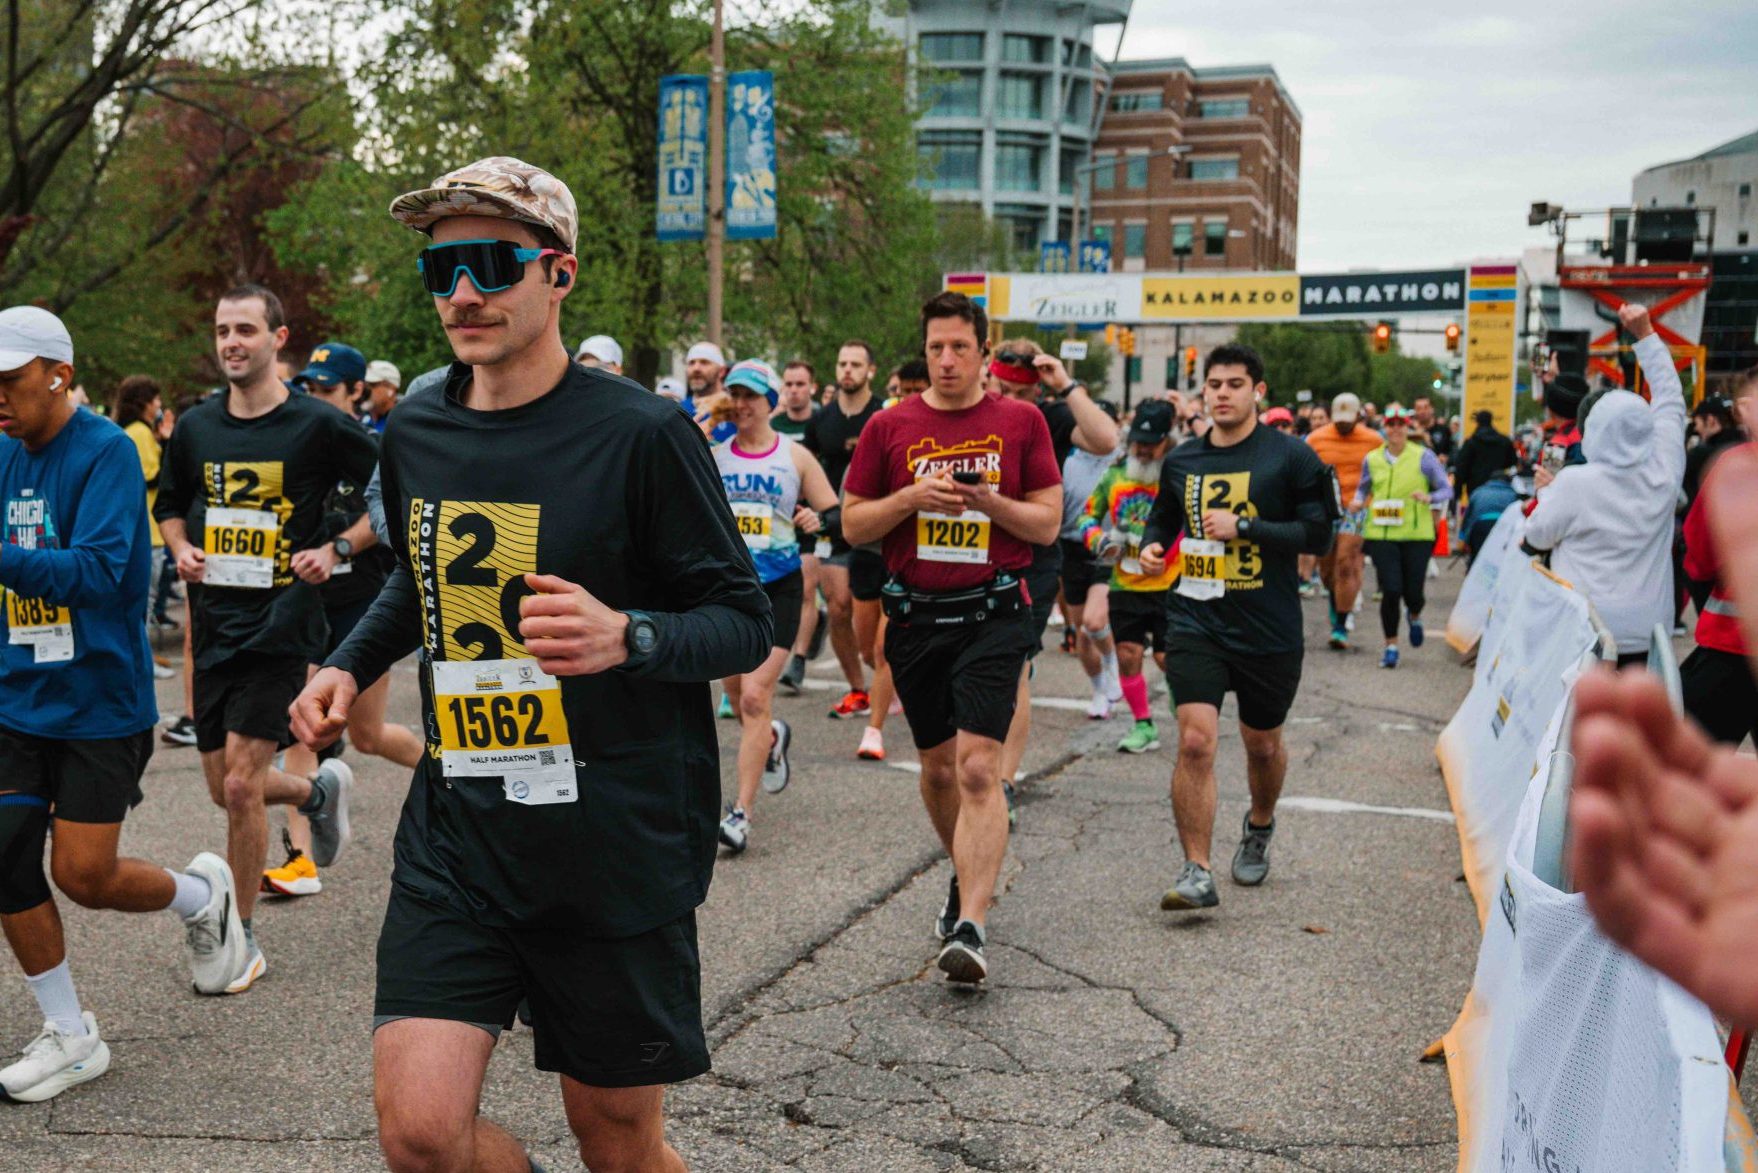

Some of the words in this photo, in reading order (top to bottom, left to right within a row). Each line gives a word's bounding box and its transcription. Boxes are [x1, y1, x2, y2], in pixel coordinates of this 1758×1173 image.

[1146, 290, 1294, 304] KALAMAZOO
[1304, 282, 1460, 304] MARATHON
[914, 453, 1001, 479] ZEIGLER
[230, 468, 261, 502] 2
[1207, 479, 1231, 509] 2
[213, 527, 265, 556] 1660
[925, 520, 980, 548] 1202
[445, 512, 498, 587] 2
[1184, 554, 1216, 578] 1694
[448, 693, 550, 748] 1562
[470, 756, 490, 764] HALF
[491, 754, 537, 763] MARATHON
